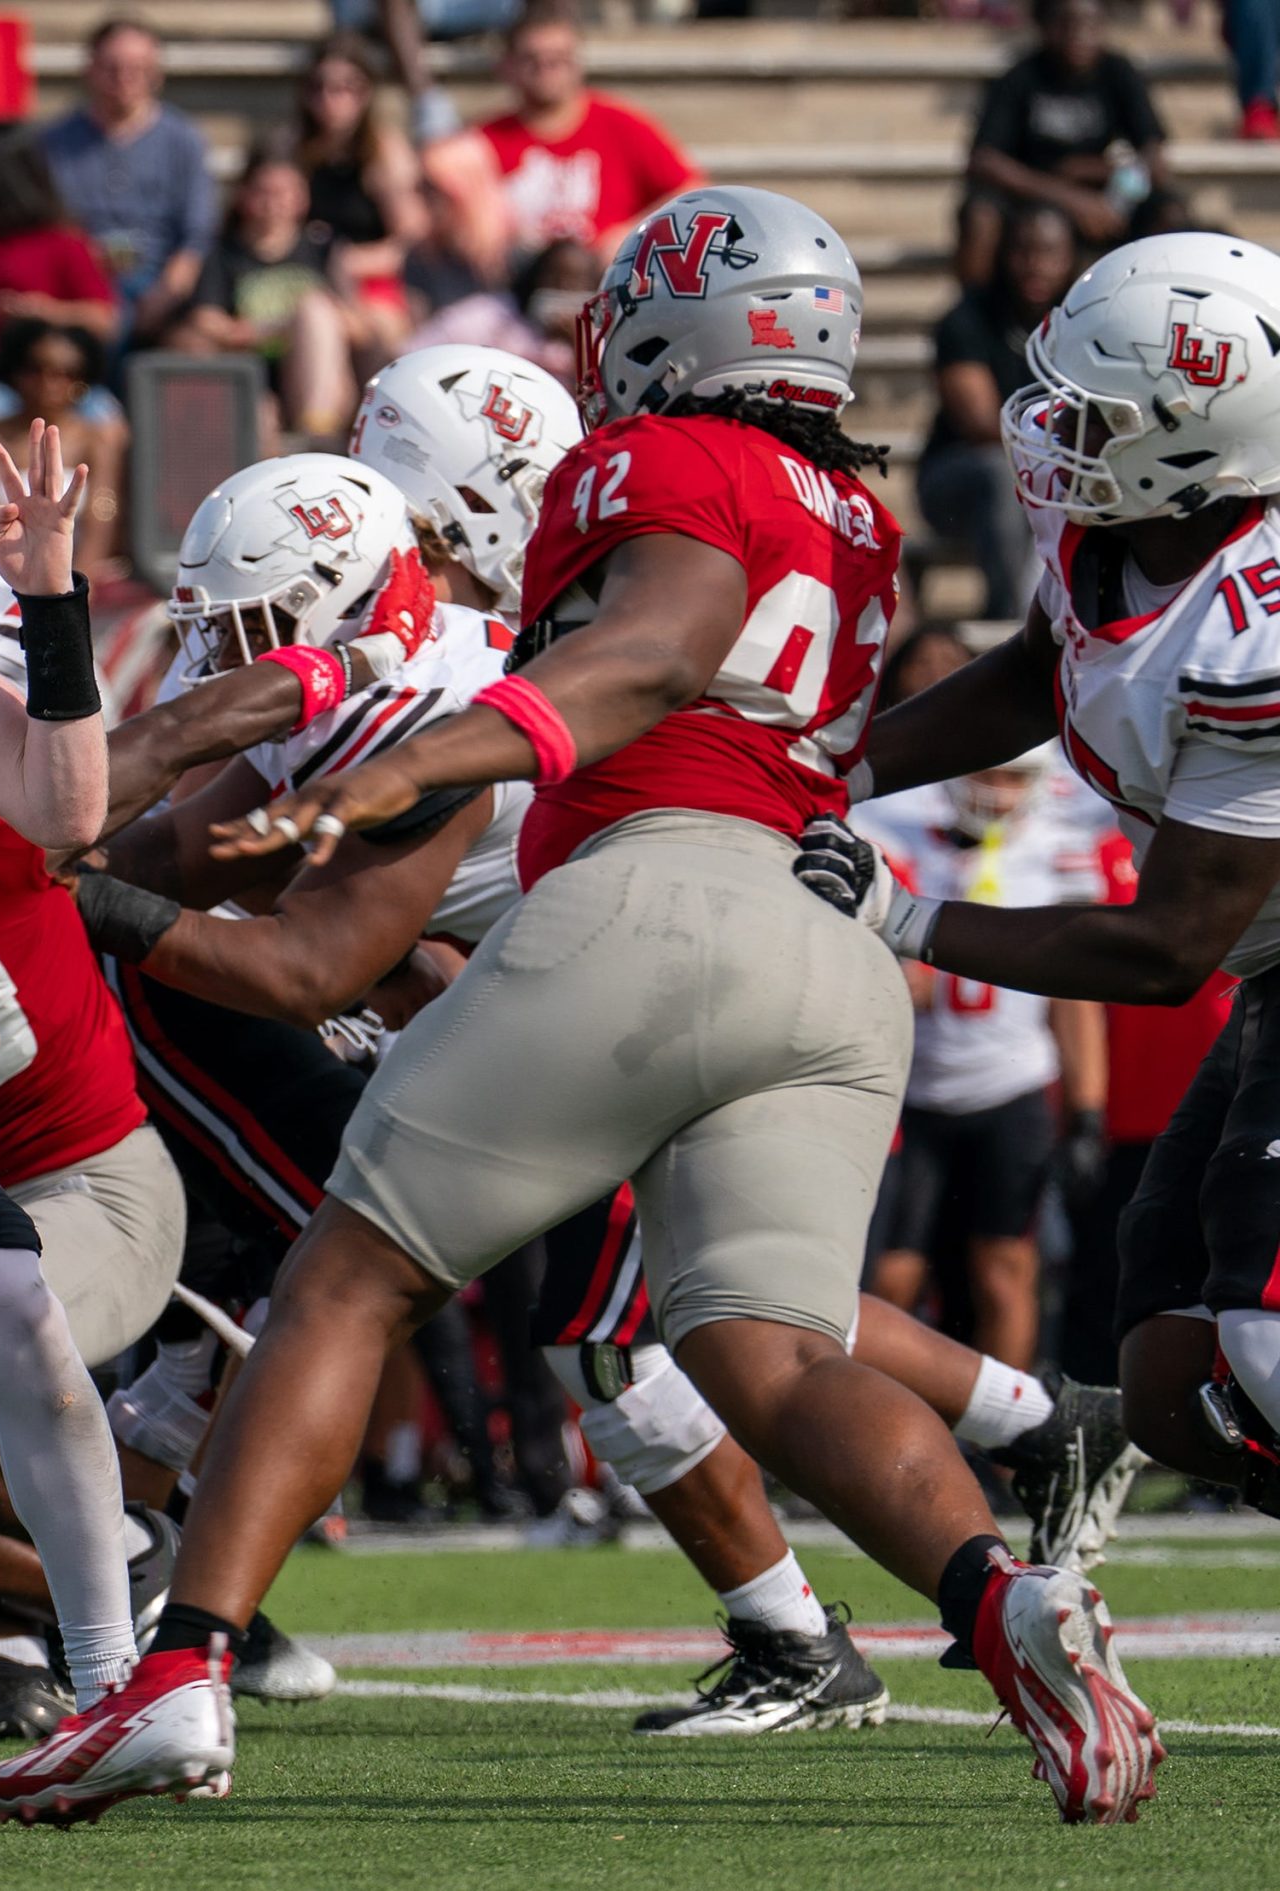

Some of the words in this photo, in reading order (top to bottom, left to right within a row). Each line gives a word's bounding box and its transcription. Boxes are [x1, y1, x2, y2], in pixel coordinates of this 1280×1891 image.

[625, 210, 735, 301] N
[1166, 322, 1233, 387] LU
[481, 383, 533, 442] LU
[288, 497, 353, 541] LU
[571, 450, 632, 535] 92
[1214, 556, 1280, 638] 15
